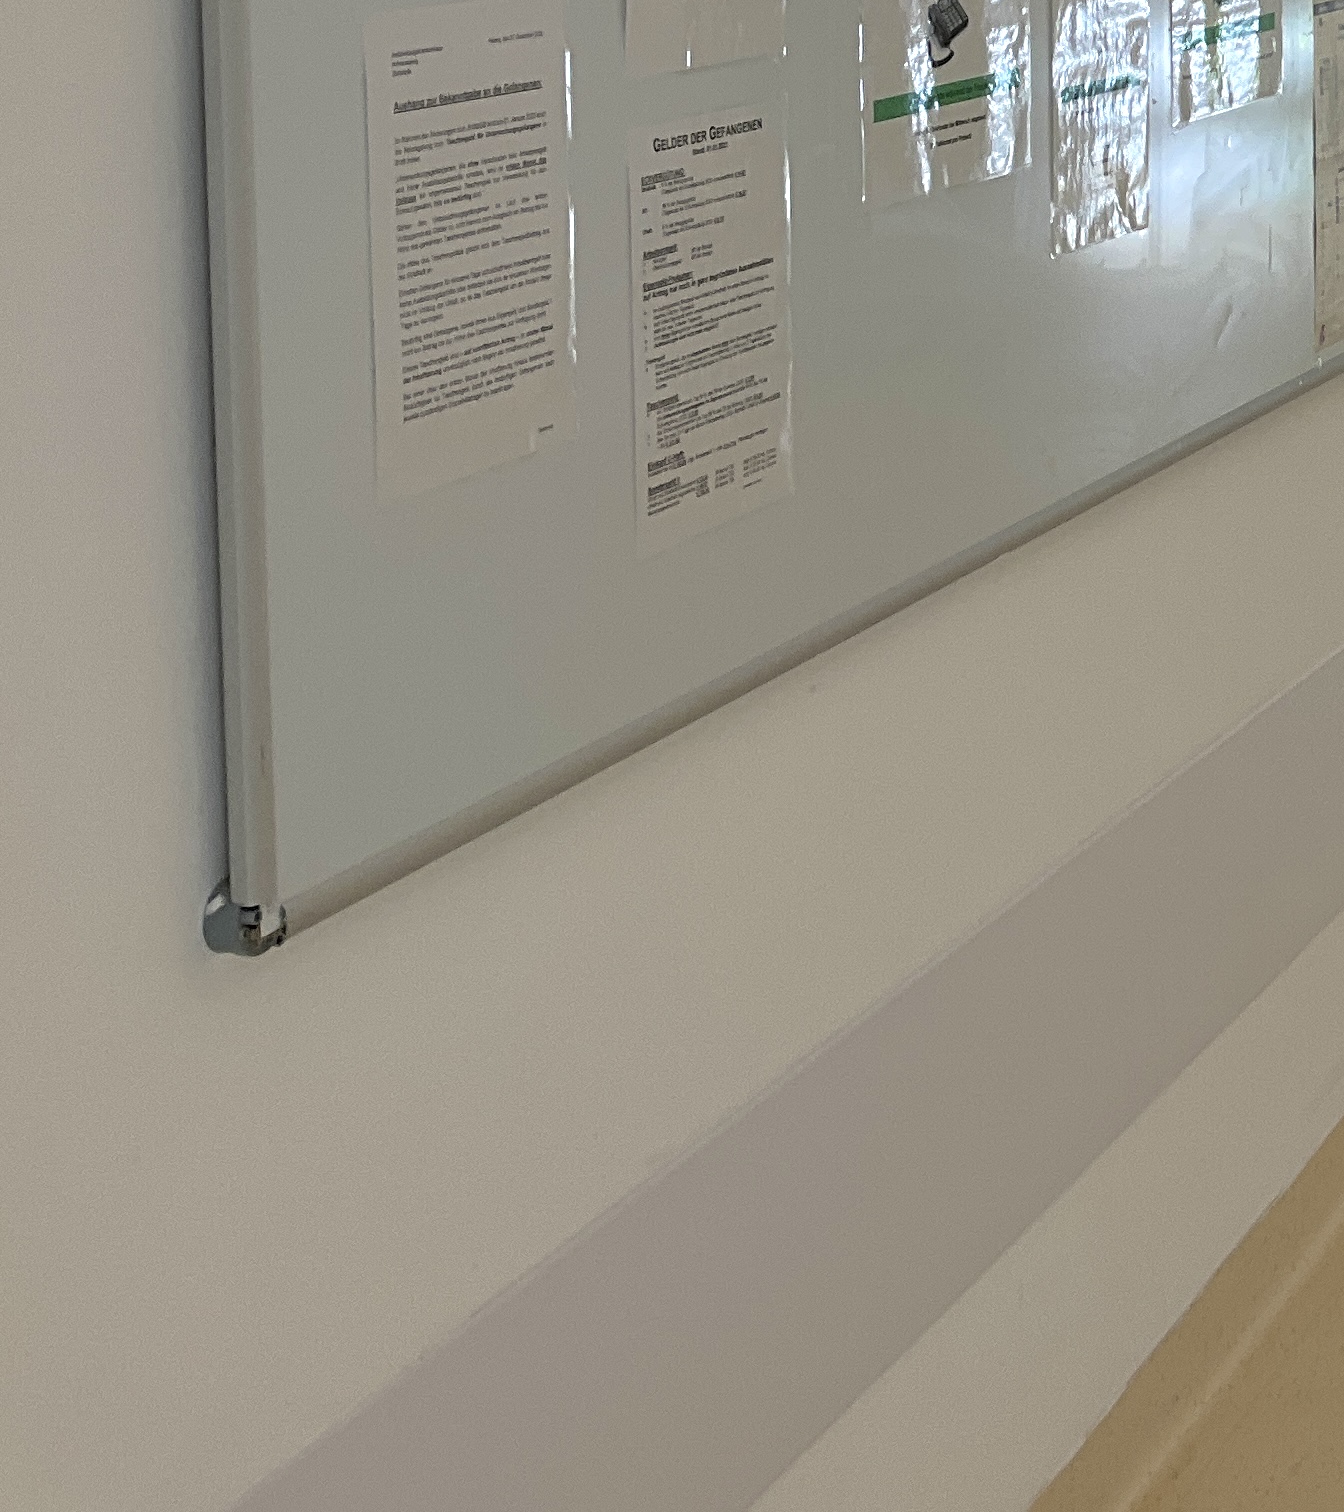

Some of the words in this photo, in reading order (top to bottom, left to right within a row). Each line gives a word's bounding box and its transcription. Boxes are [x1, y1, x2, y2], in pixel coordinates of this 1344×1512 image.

[653, 134, 689, 153] GELDER
[690, 130, 707, 146] DER
[709, 117, 763, 141] GEFANGENEN
